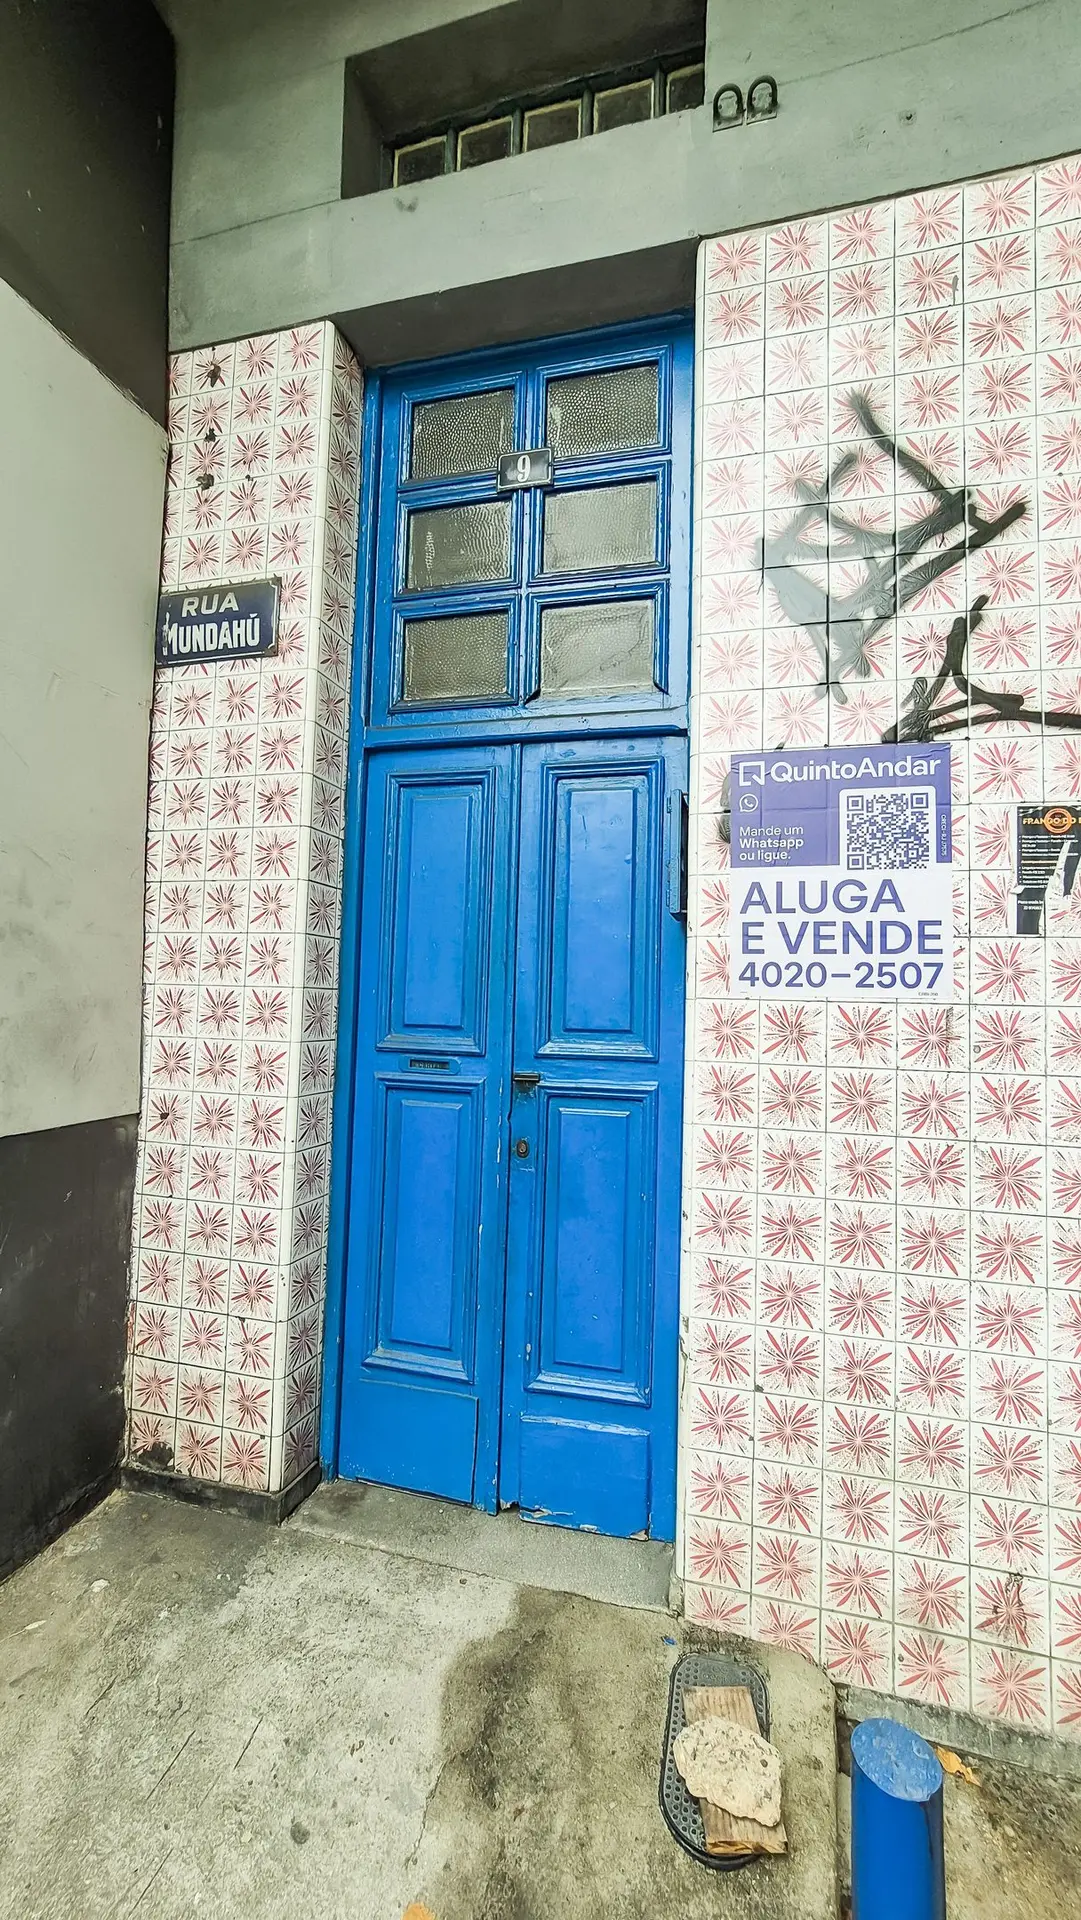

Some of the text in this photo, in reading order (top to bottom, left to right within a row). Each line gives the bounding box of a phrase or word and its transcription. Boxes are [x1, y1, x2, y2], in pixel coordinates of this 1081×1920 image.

[517, 455, 531, 483] 9
[181, 592, 239, 618] RUA
[770, 756, 941, 783] QuintoAndar
[739, 826, 804, 837] Mande um
[739, 838, 804, 850] Whatsapp
[739, 850, 791, 863] ou ligue.
[740, 878, 906, 915] ALUGA
[741, 920, 944, 955] E VENDE
